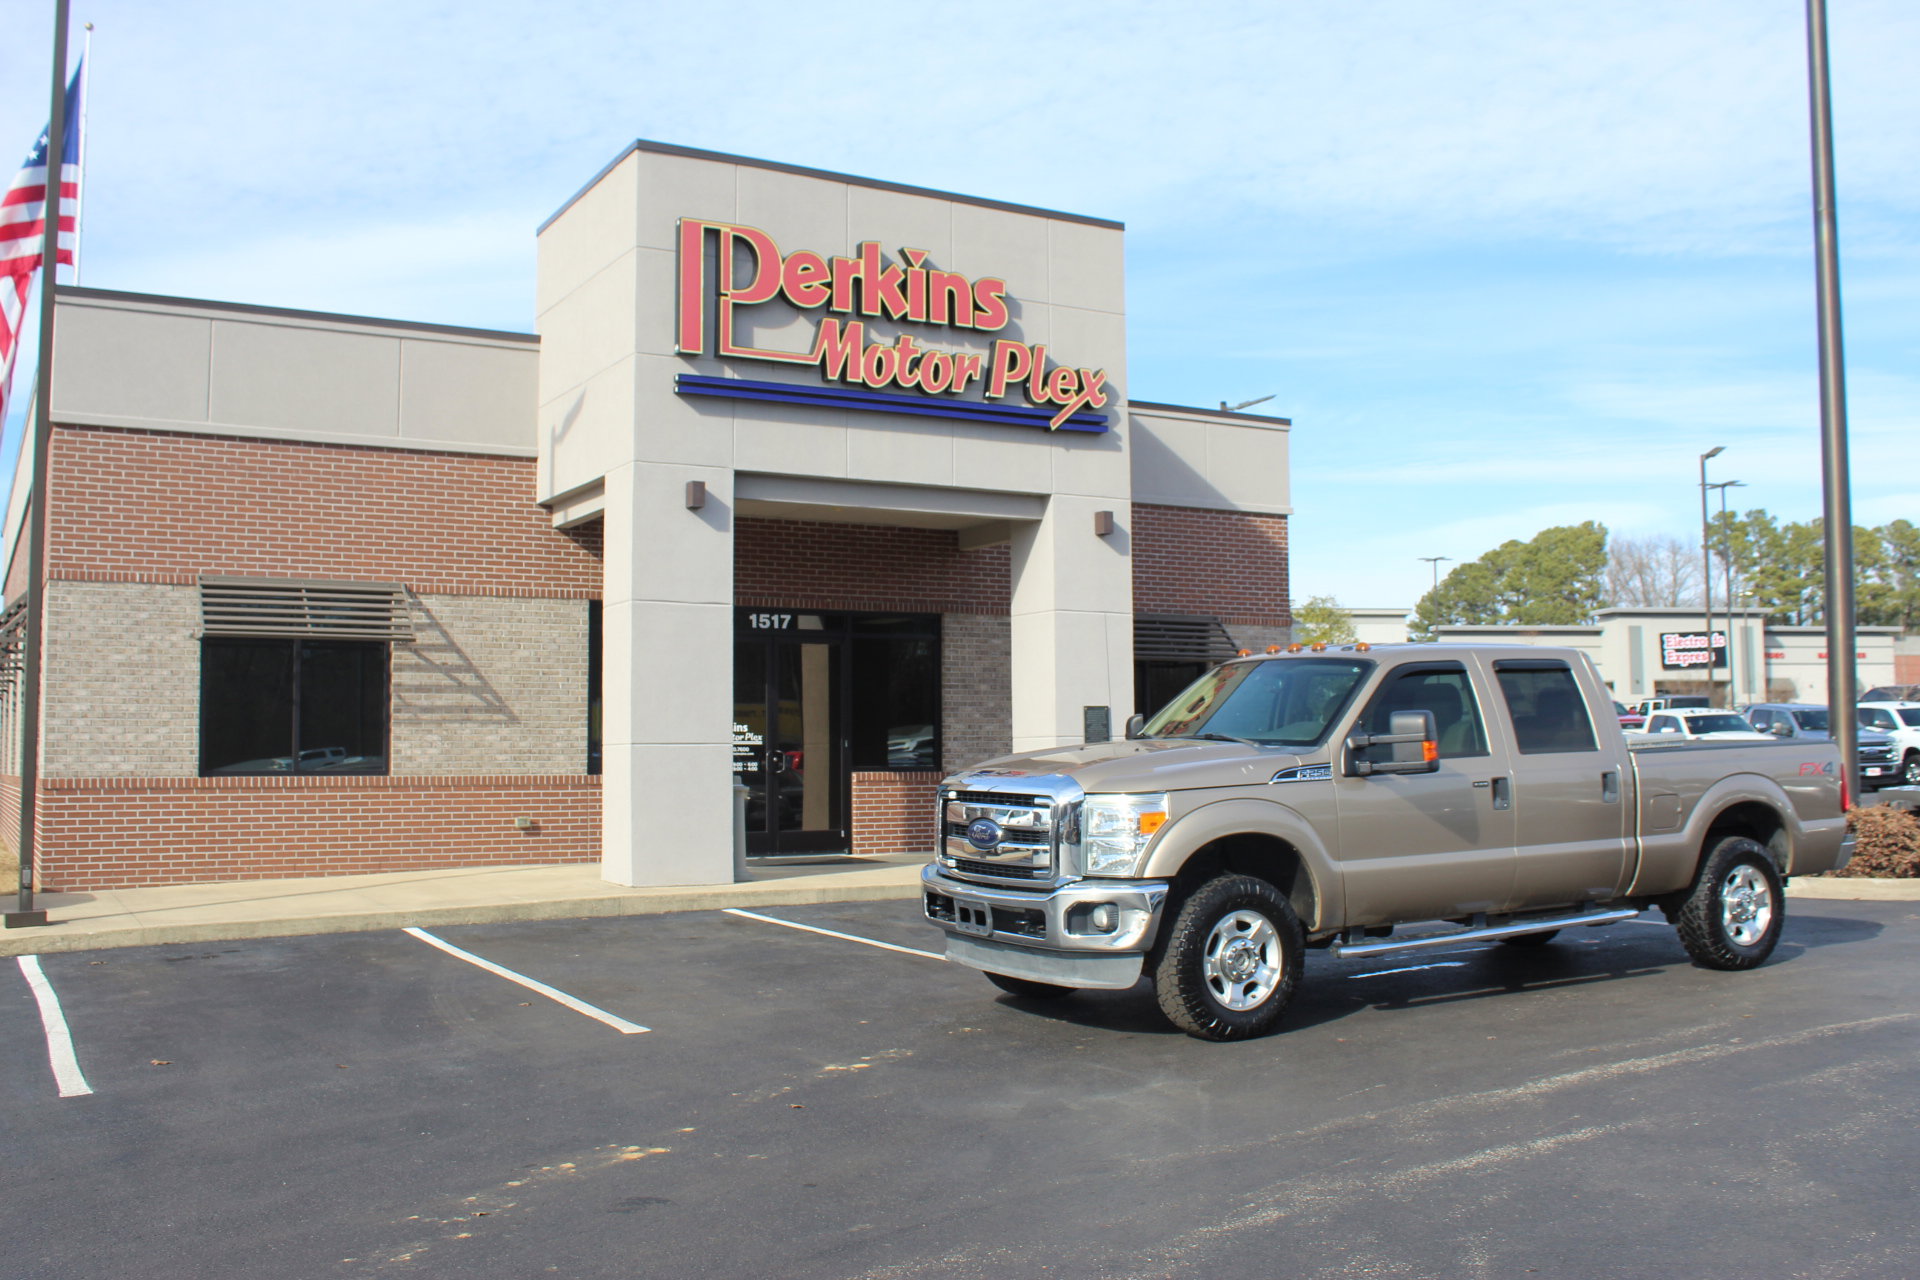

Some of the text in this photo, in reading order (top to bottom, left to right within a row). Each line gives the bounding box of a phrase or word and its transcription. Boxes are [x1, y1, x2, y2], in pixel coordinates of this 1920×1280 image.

[676, 217, 1009, 354] Perkins
[814, 317, 1108, 431] Motor Plex
[749, 613, 791, 629] 1517
[1663, 633, 1726, 649] Electroic
[1664, 649, 1715, 667] Expres
[744, 732, 763, 741] Plex
[1800, 761, 1833, 776] FX4
